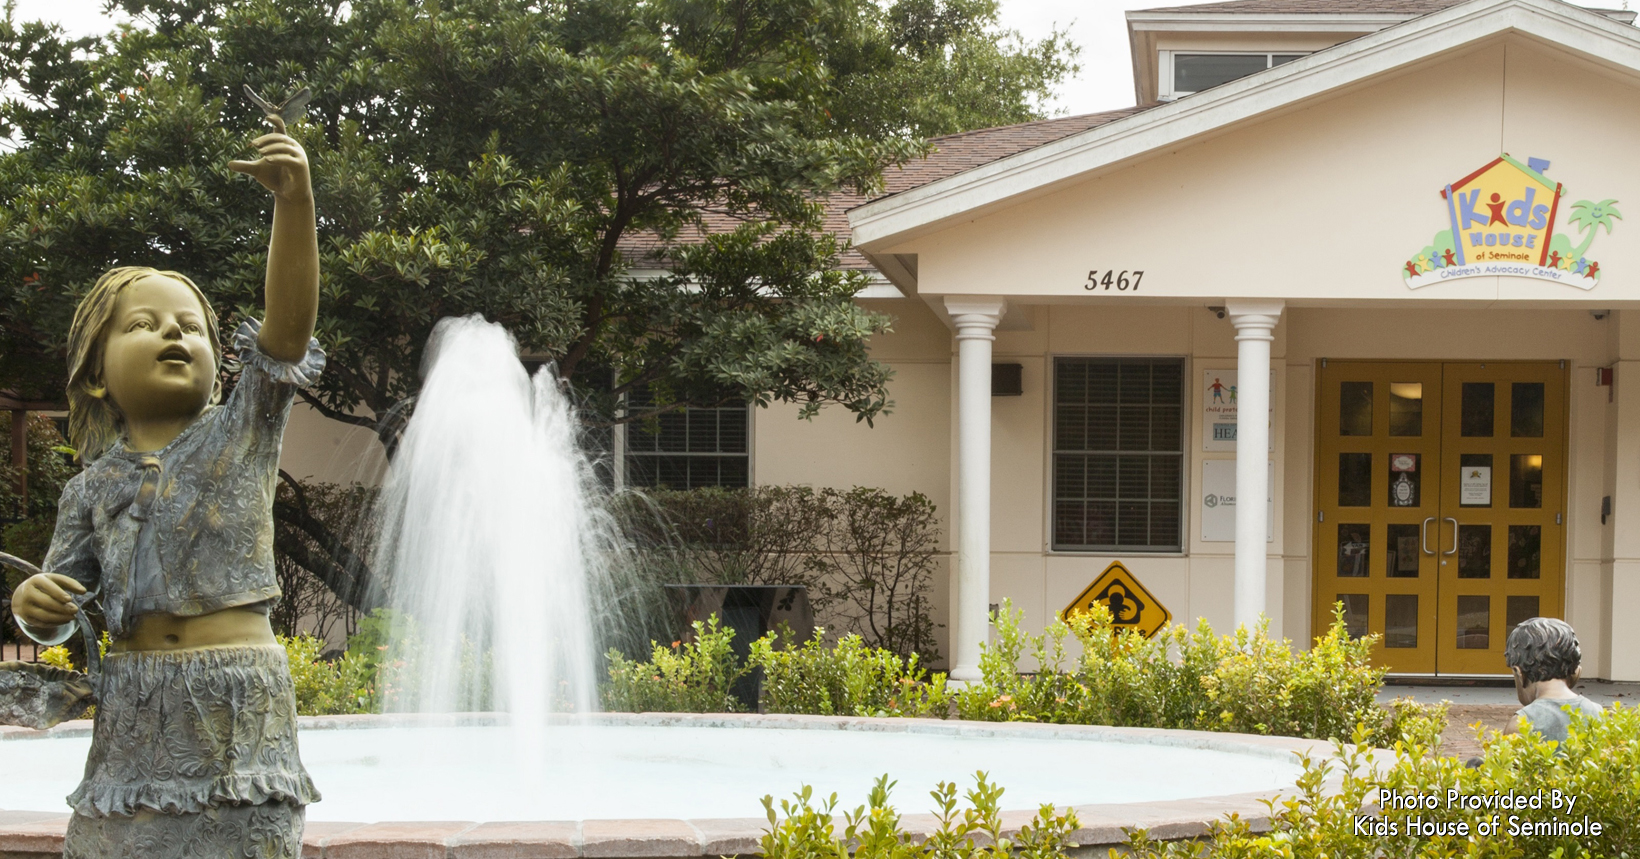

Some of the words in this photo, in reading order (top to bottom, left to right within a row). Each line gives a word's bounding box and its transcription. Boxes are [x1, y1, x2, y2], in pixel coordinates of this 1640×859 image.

[1458, 187, 1550, 230] Kids
[1469, 232, 1538, 249] HOUSE
[1476, 252, 1486, 261] of
[1488, 251, 1530, 261] Seminole
[1084, 269, 1145, 291] 5467
[1440, 265, 1482, 280] Children's
[1485, 265, 1530, 276] Advocacy
[1532, 267, 1562, 280] Center
[1214, 428, 1238, 439] HEA
